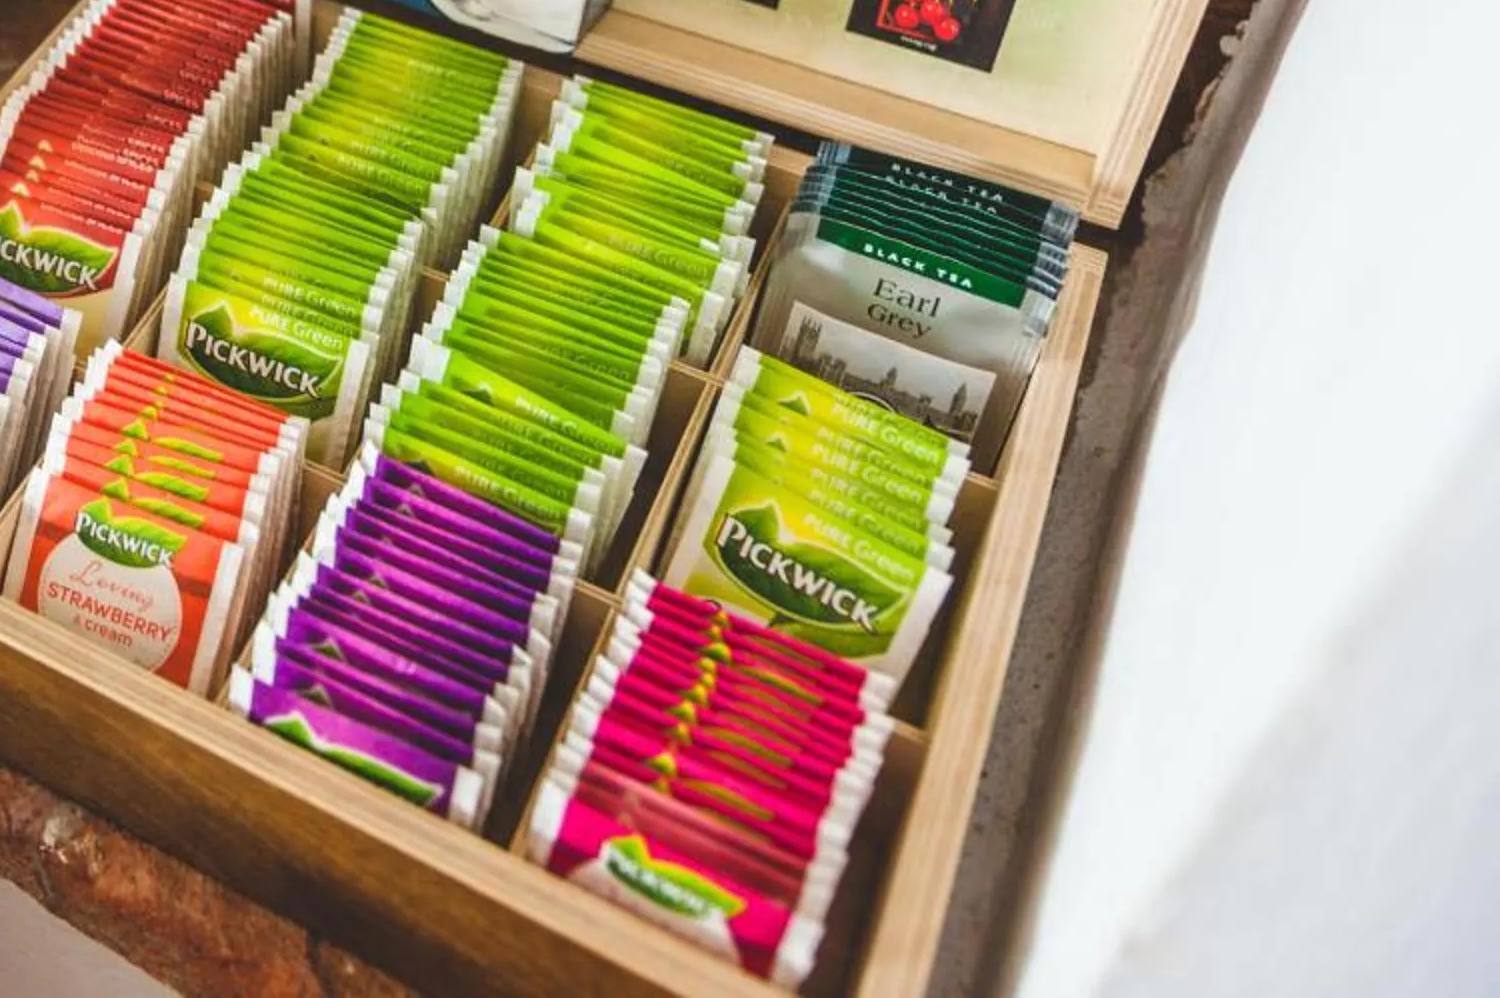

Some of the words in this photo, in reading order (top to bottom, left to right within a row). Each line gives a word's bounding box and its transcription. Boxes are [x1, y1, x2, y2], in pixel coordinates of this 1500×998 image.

[961, 196, 998, 215] TEA
[967, 183, 1004, 203] TEA
[863, 242, 926, 271] BLACK
[935, 267, 975, 290] TEA
[871, 277, 942, 318] Earl
[248, 305, 290, 332] PURE
[292, 321, 344, 348] Green
[866, 301, 933, 340] Grey
[185, 321, 322, 399] PICKWICK
[75, 511, 174, 569] PICKWICK
[803, 512, 852, 549] PURE
[854, 539, 916, 581] Green
[715, 514, 880, 637] PICKWICK
[47, 581, 173, 642] STRAWBERRY
[83, 615, 133, 649] cream
